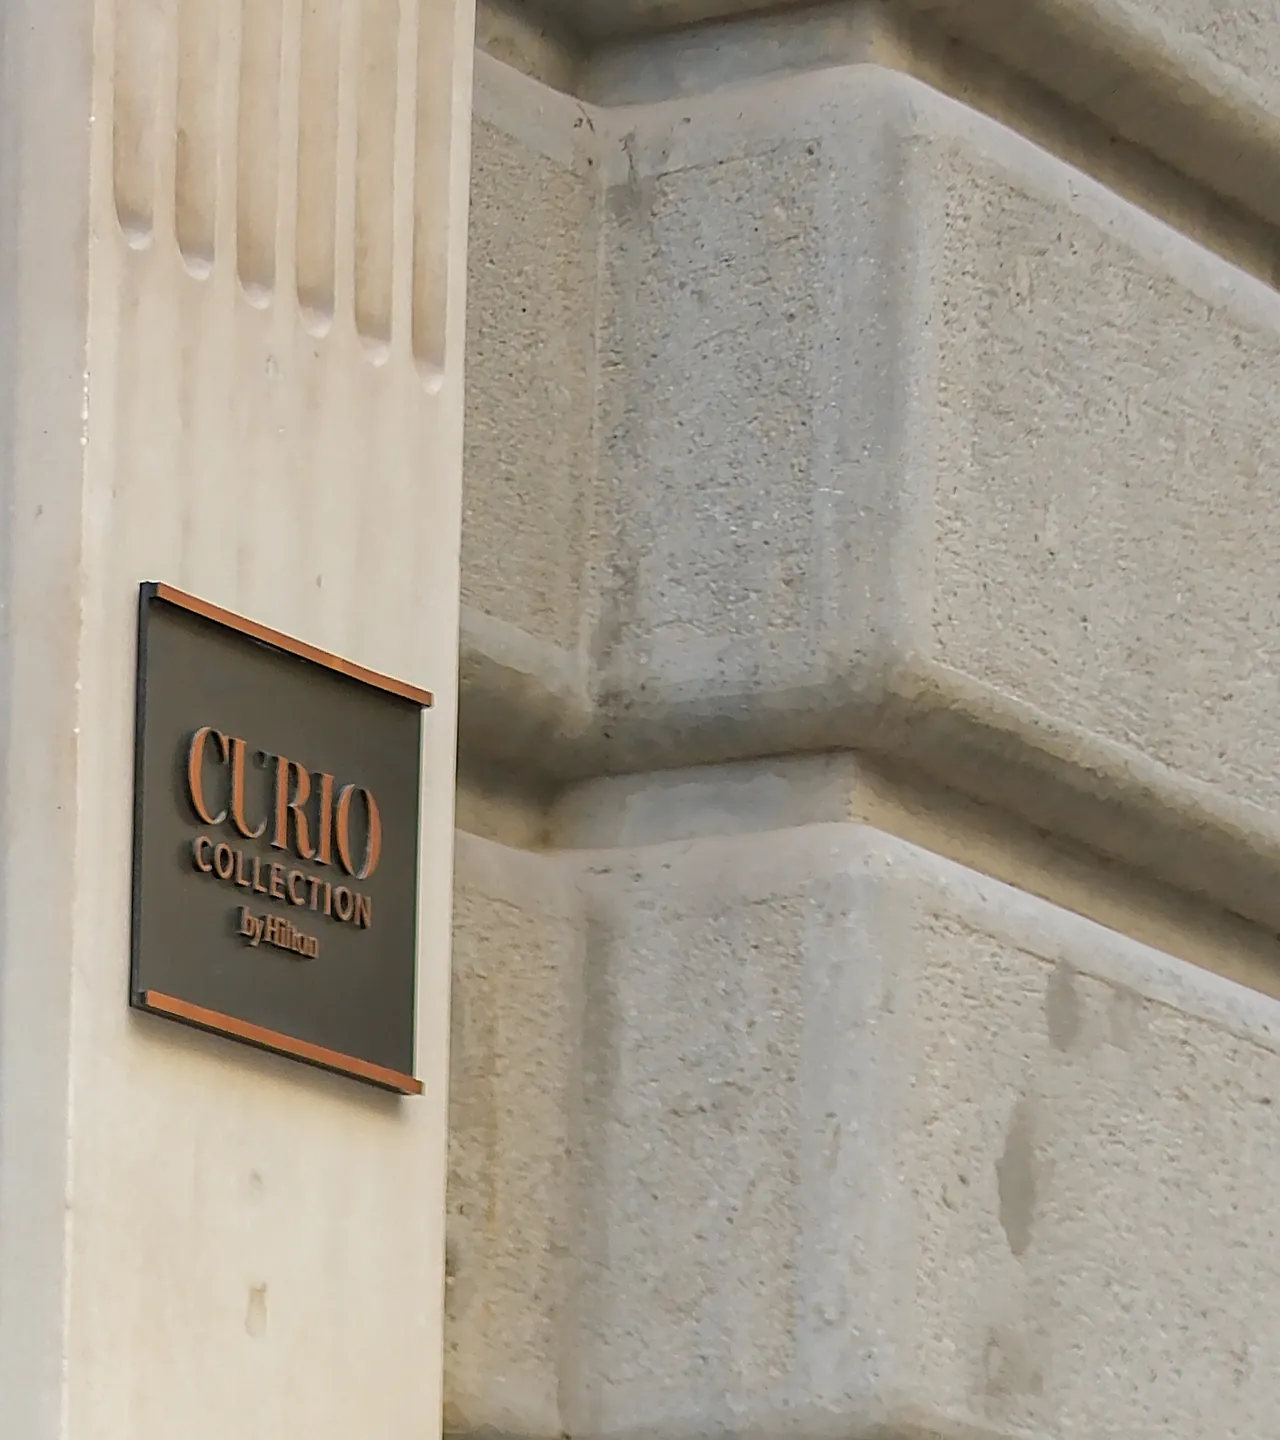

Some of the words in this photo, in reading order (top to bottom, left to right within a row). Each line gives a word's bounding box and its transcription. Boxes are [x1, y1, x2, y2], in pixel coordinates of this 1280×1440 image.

[188, 726, 382, 880] CURIO
[193, 835, 372, 929] COLLECTION
[238, 905, 264, 947] by
[263, 913, 319, 959] Hilton
